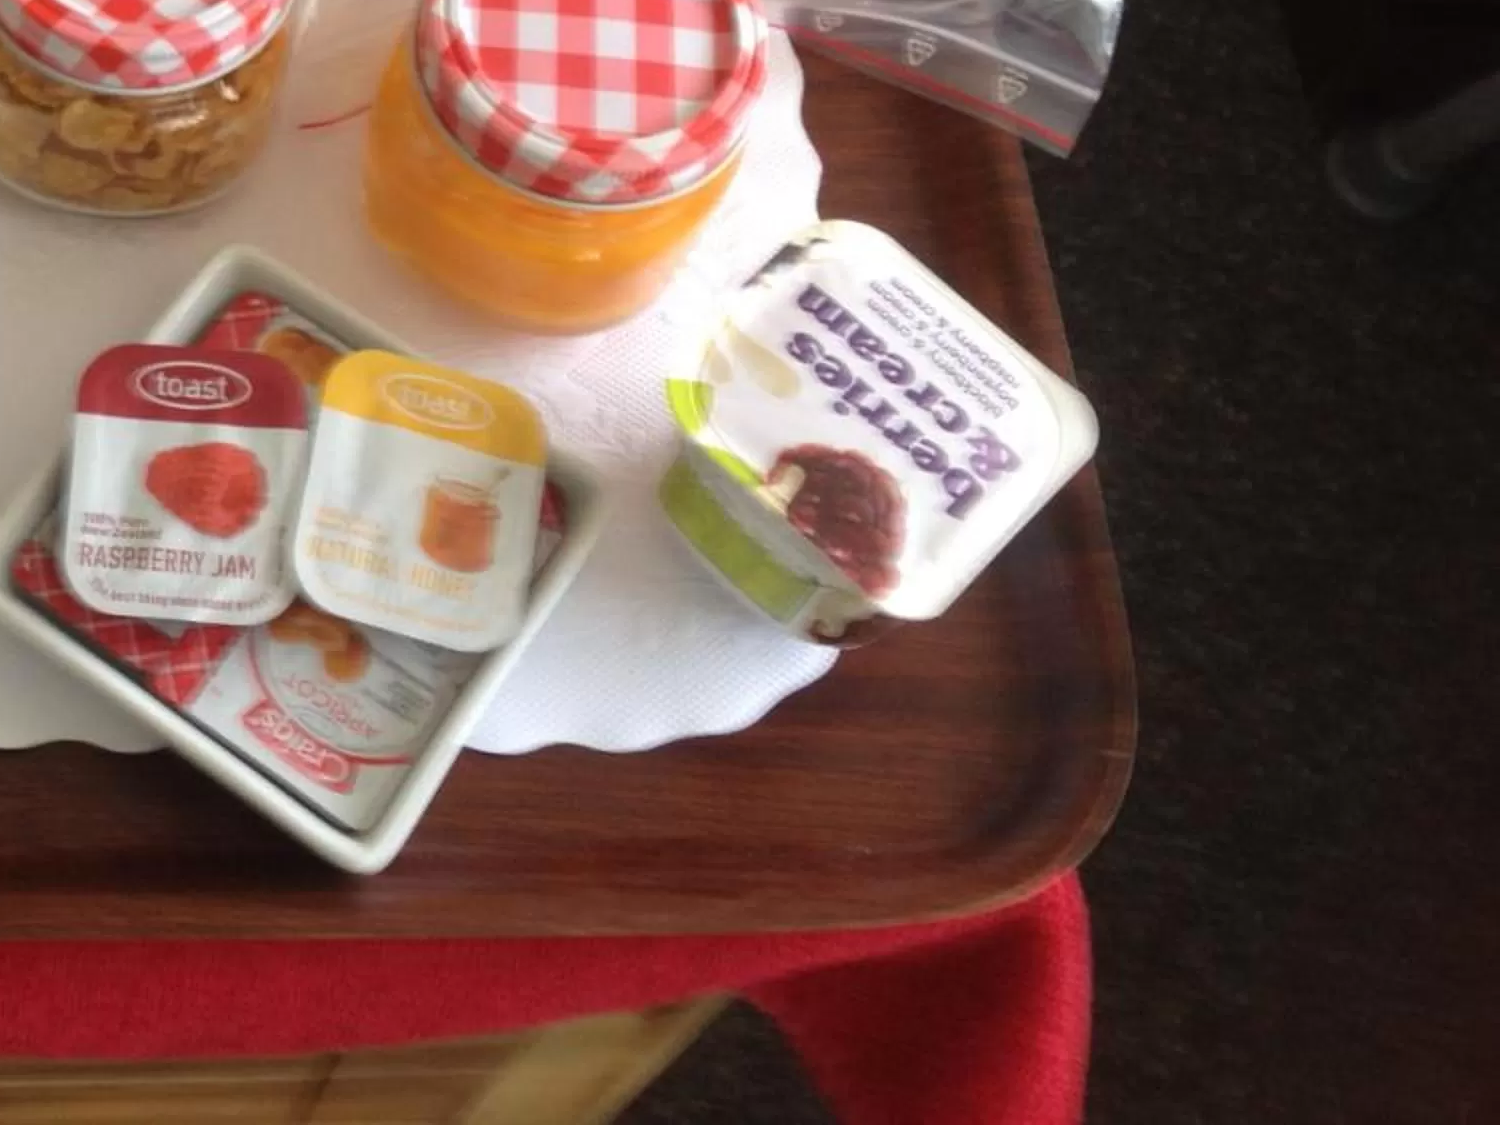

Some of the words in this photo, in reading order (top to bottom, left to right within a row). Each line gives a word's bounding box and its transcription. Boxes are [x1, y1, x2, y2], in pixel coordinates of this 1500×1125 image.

[865, 297, 912, 340] cream
[890, 277, 935, 318] cream
[797, 283, 969, 433] cream
[155, 371, 228, 402] toast
[786, 332, 984, 520] berries
[79, 542, 206, 574] RASPBERRY
[212, 554, 256, 579] JAM
[281, 674, 384, 738] APRICOT
